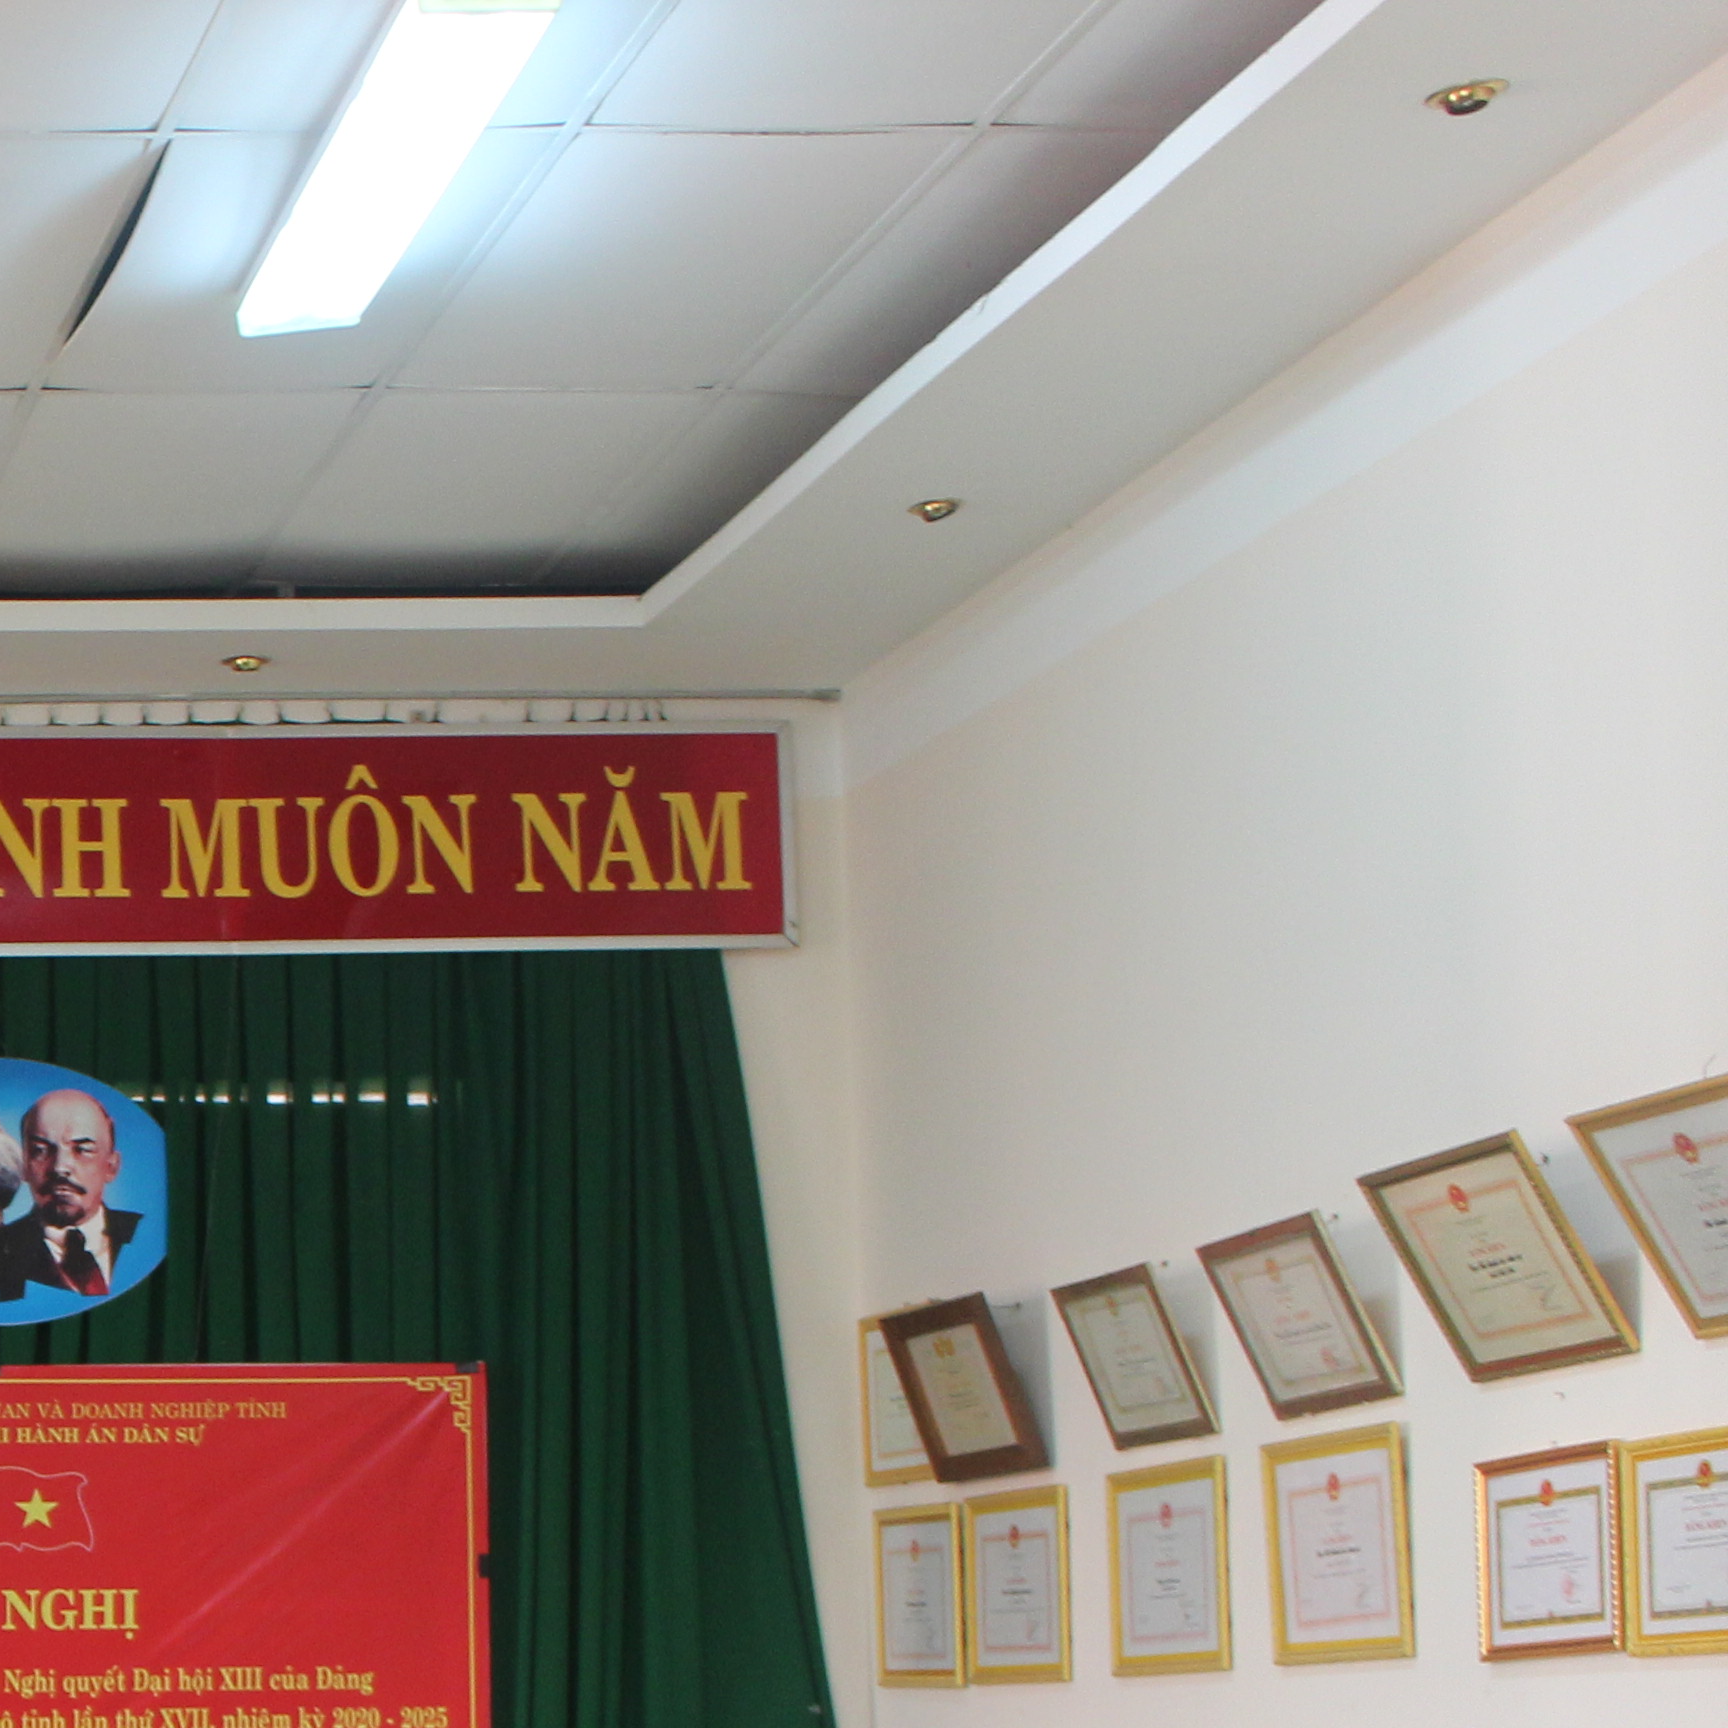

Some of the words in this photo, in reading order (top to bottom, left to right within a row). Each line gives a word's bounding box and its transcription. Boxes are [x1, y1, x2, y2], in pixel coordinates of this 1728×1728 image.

[159, 764, 477, 899] MUÔN
[512, 767, 752, 893] NĂM
[37, 1399, 66, 1420] VÀ
[72, 1403, 145, 1421] DOANH
[17, 1423, 81, 1445] HÀNH
[86, 1423, 118, 1445] ÁN
[124, 1423, 170, 1445] DÂN
[176, 1425, 206, 1447] SỰ
[2, 1589, 141, 1641] NGHỊ
[4, 1669, 57, 1700] Nghị
[63, 1666, 127, 1700] quyết
[133, 1668, 173, 1698] Đại
[178, 1668, 215, 1697] hội
[220, 1667, 264, 1692] XIII
[270, 1666, 311, 1692] của
